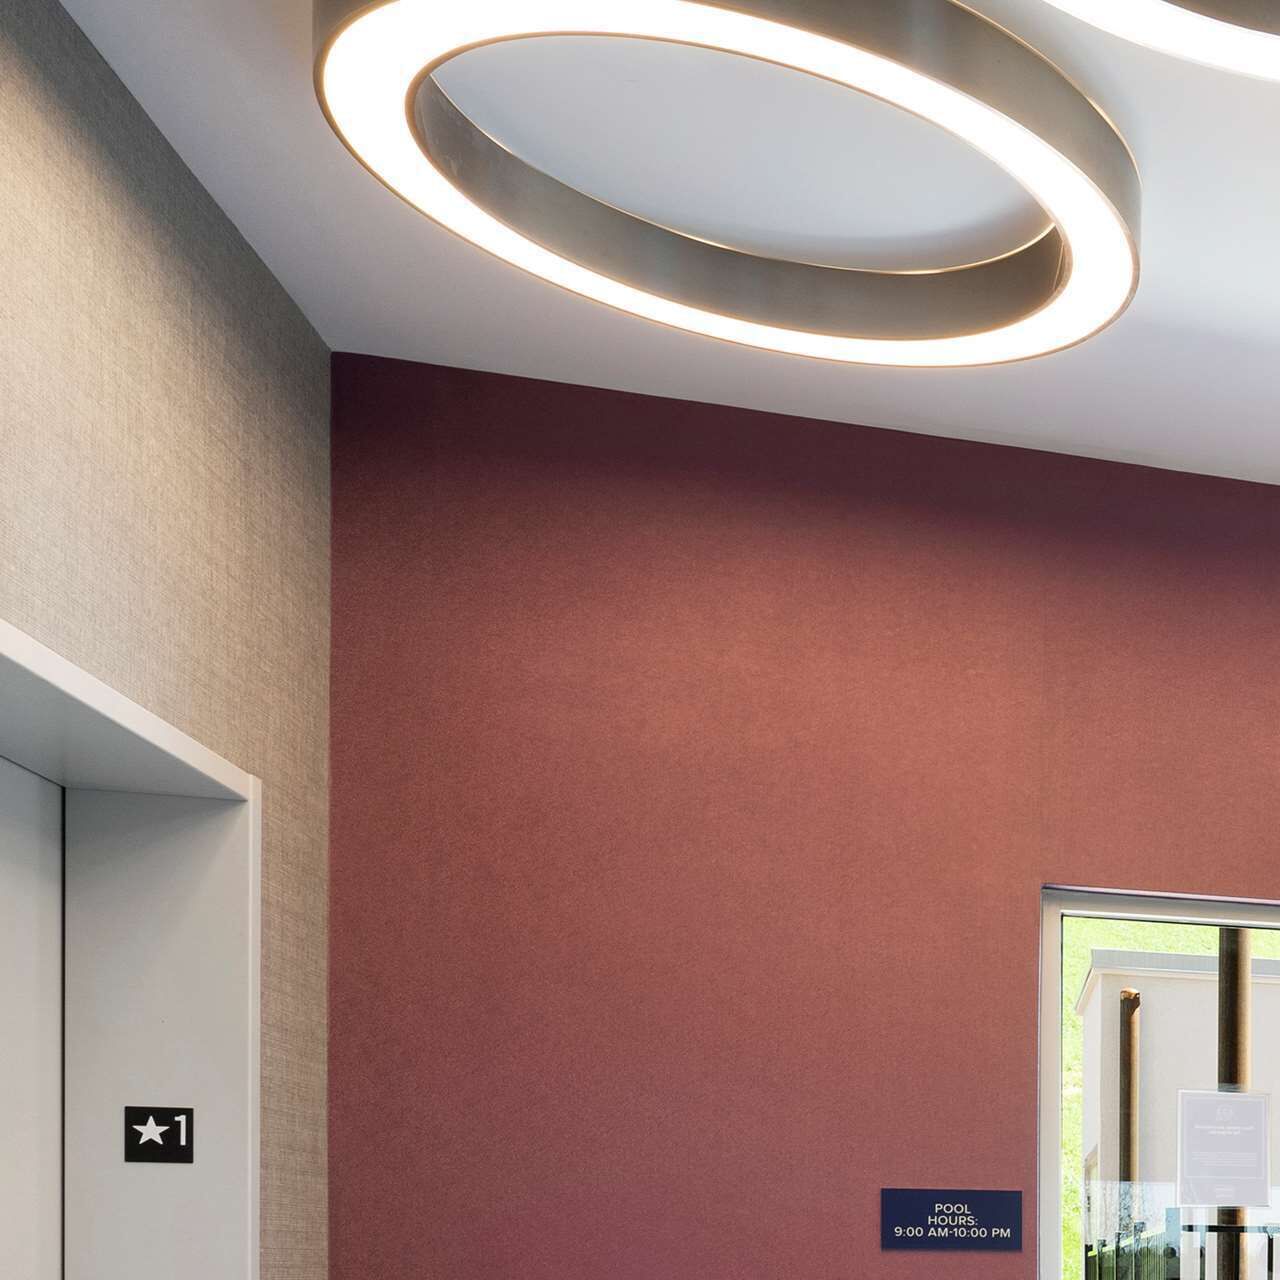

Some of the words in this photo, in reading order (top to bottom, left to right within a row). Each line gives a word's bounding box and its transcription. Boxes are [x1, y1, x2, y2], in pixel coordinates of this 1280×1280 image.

[935, 1203, 971, 1214] POOL
[927, 1215, 978, 1226] HOURS:
[894, 1227, 924, 1238] 9:00
[928, 1227, 988, 1238] AM-10:00
[991, 1228, 1011, 1238] PM
